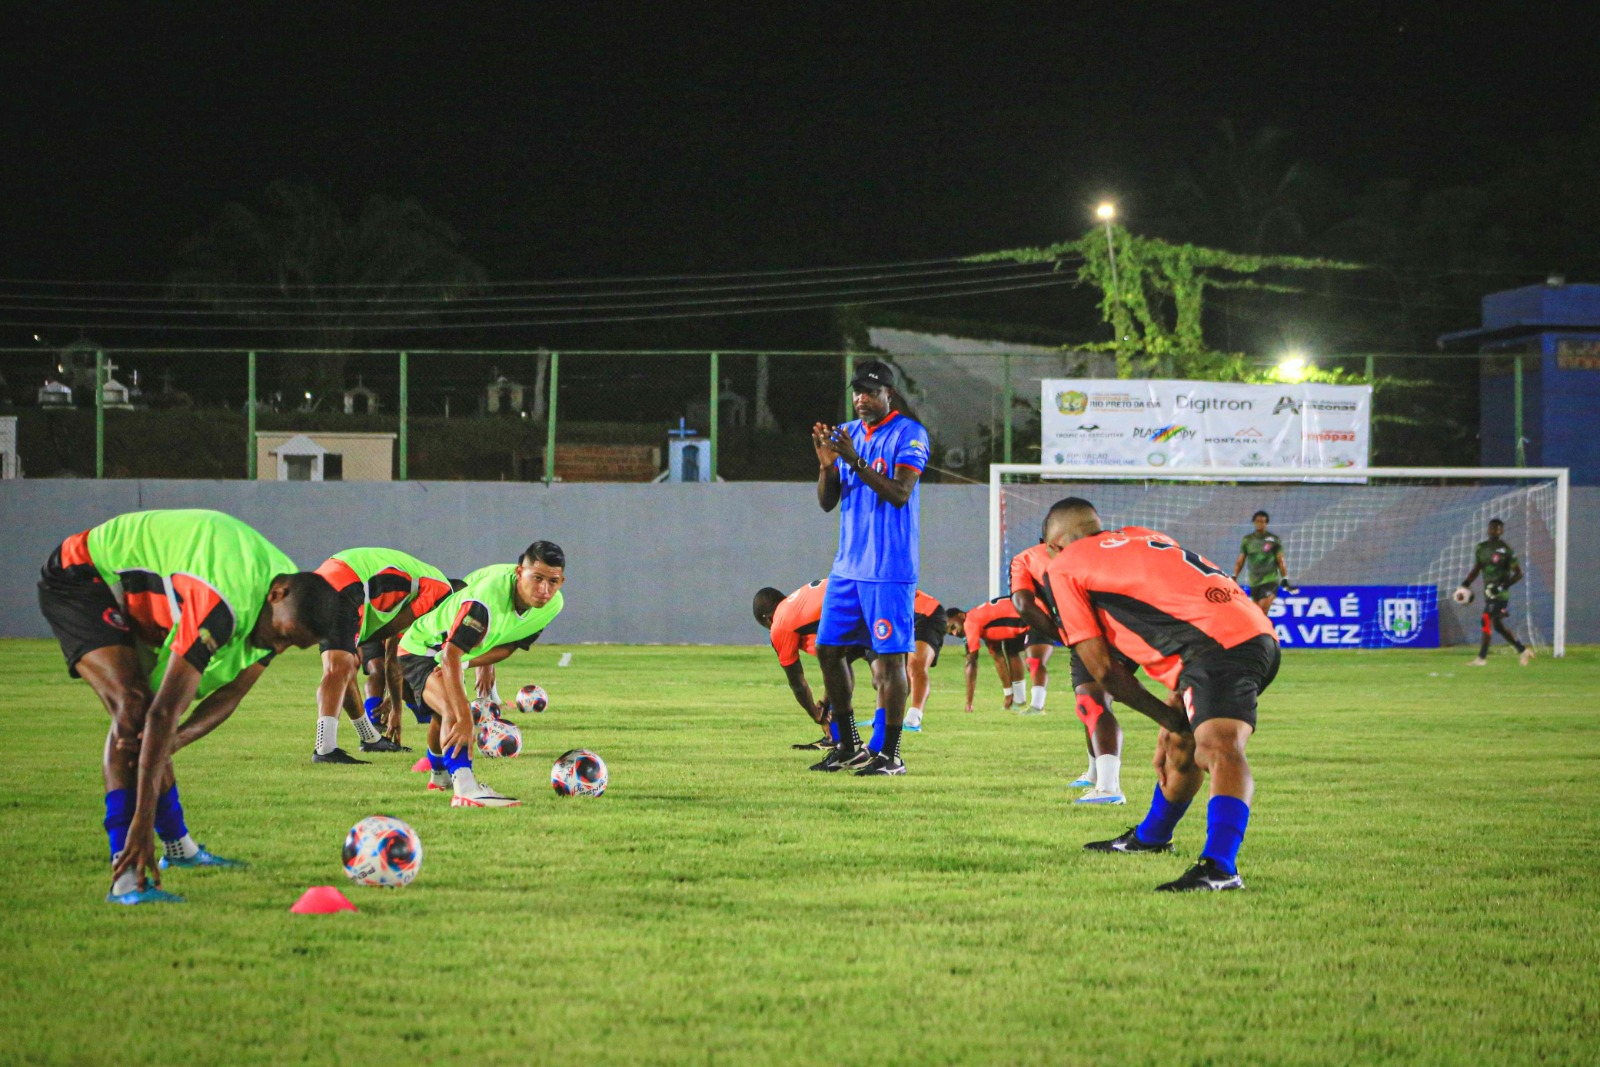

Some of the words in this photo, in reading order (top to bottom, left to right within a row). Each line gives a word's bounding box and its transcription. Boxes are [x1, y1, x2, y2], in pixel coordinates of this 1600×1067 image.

[1090, 400, 1104, 409] RIO
[1105, 400, 1132, 409] PRETO
[1133, 400, 1145, 409] DA
[1146, 400, 1161, 409] EVA
[1176, 395, 1252, 414] Digitron
[1267, 596, 1335, 618] STA
[1339, 592, 1360, 618] É
[1297, 624, 1361, 644] VEZ
